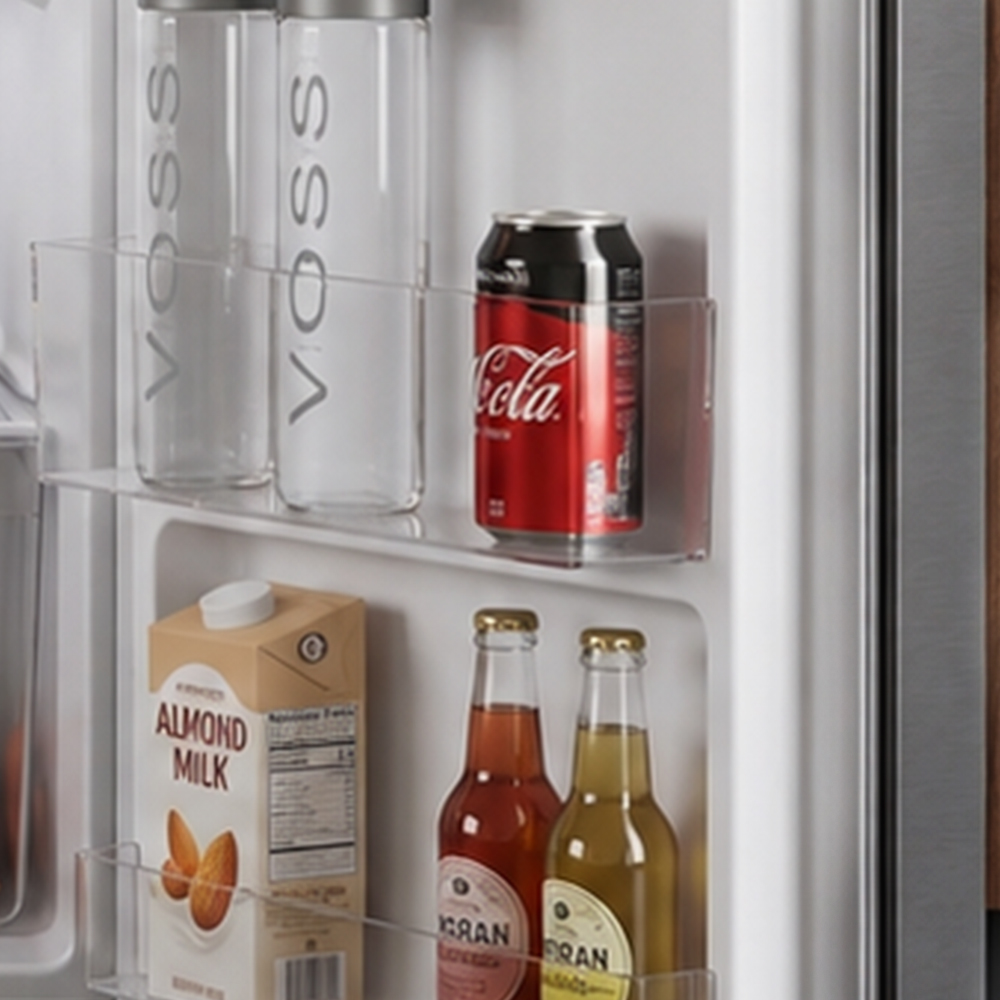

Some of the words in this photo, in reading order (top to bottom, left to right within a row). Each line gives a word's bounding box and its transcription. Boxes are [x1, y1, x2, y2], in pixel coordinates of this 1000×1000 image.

[145, 63, 181, 402] VOSS
[289, 74, 329, 426] VOSS
[473, 344, 577, 422] Cola
[156, 702, 248, 752] ALMOND
[173, 747, 229, 791] MILK
